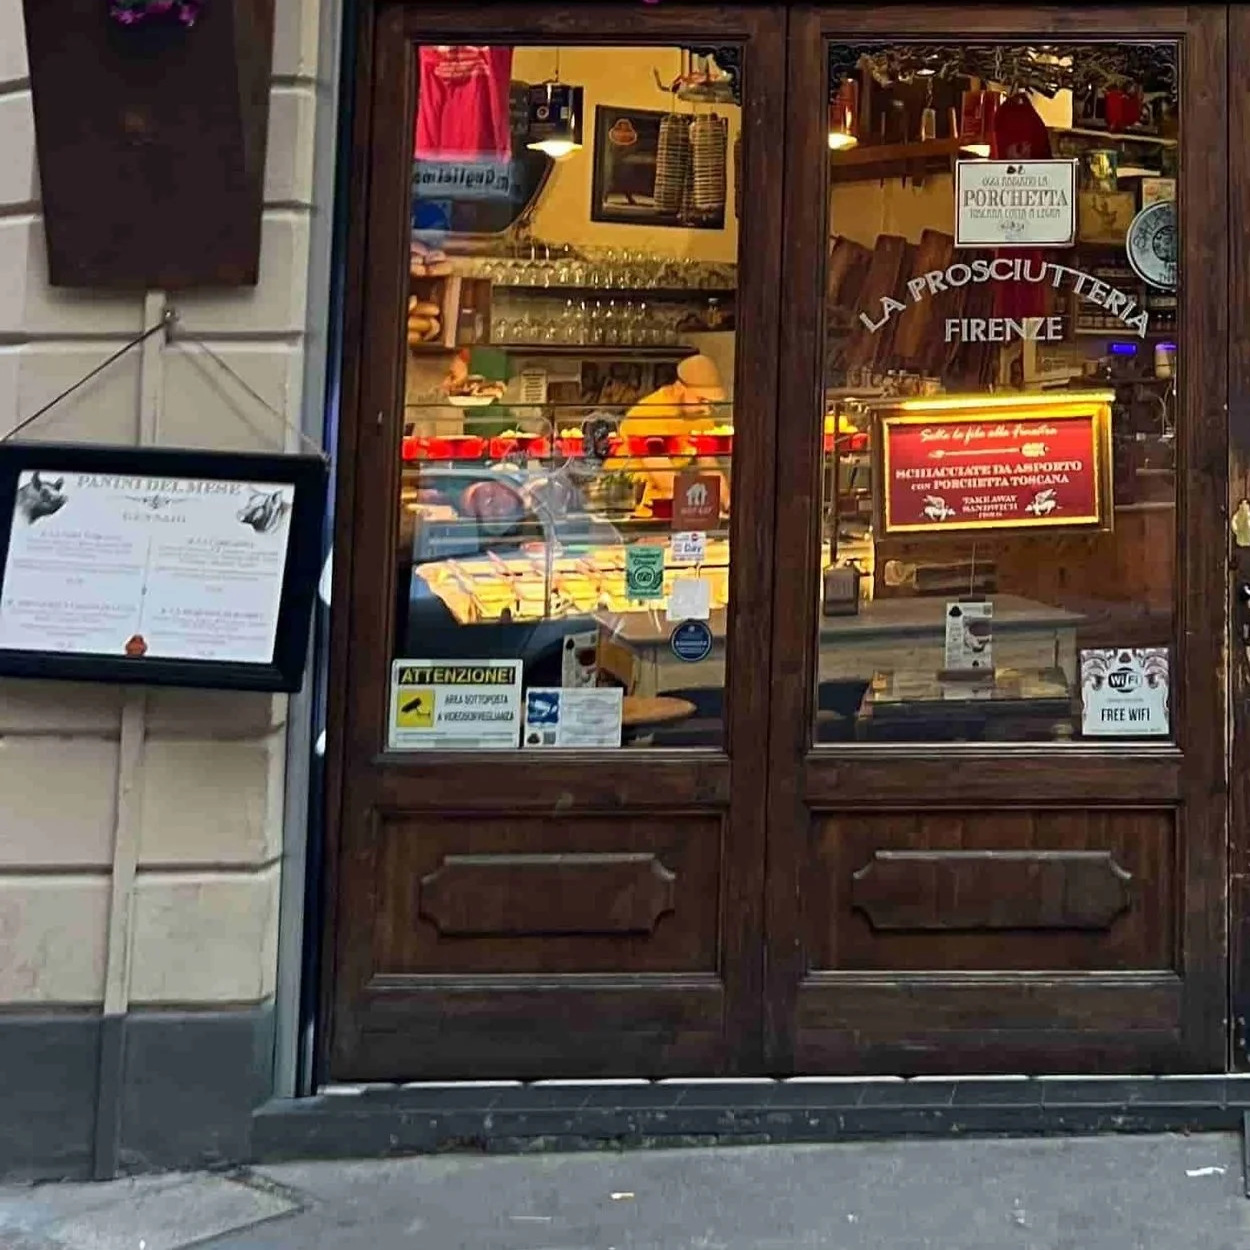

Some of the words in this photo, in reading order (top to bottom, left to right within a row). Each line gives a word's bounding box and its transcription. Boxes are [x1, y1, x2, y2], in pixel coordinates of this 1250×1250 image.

[963, 188, 1069, 208] PORCHETTA
[859, 295, 907, 334] LA
[906, 257, 1150, 339] PROSCIUTTERIA
[944, 316, 1064, 342] FIRENZE
[895, 463, 991, 480] SCHIACCIATE
[992, 462, 1012, 475] DA
[1013, 460, 1082, 475] ASPORTO
[933, 477, 1011, 490] PORCHETTA
[1011, 474, 1070, 486] TOSCANA
[400, 667, 514, 684] ATTENZIONE!
[1101, 707, 1126, 722] FREE
[1128, 707, 1150, 722] WIFI
